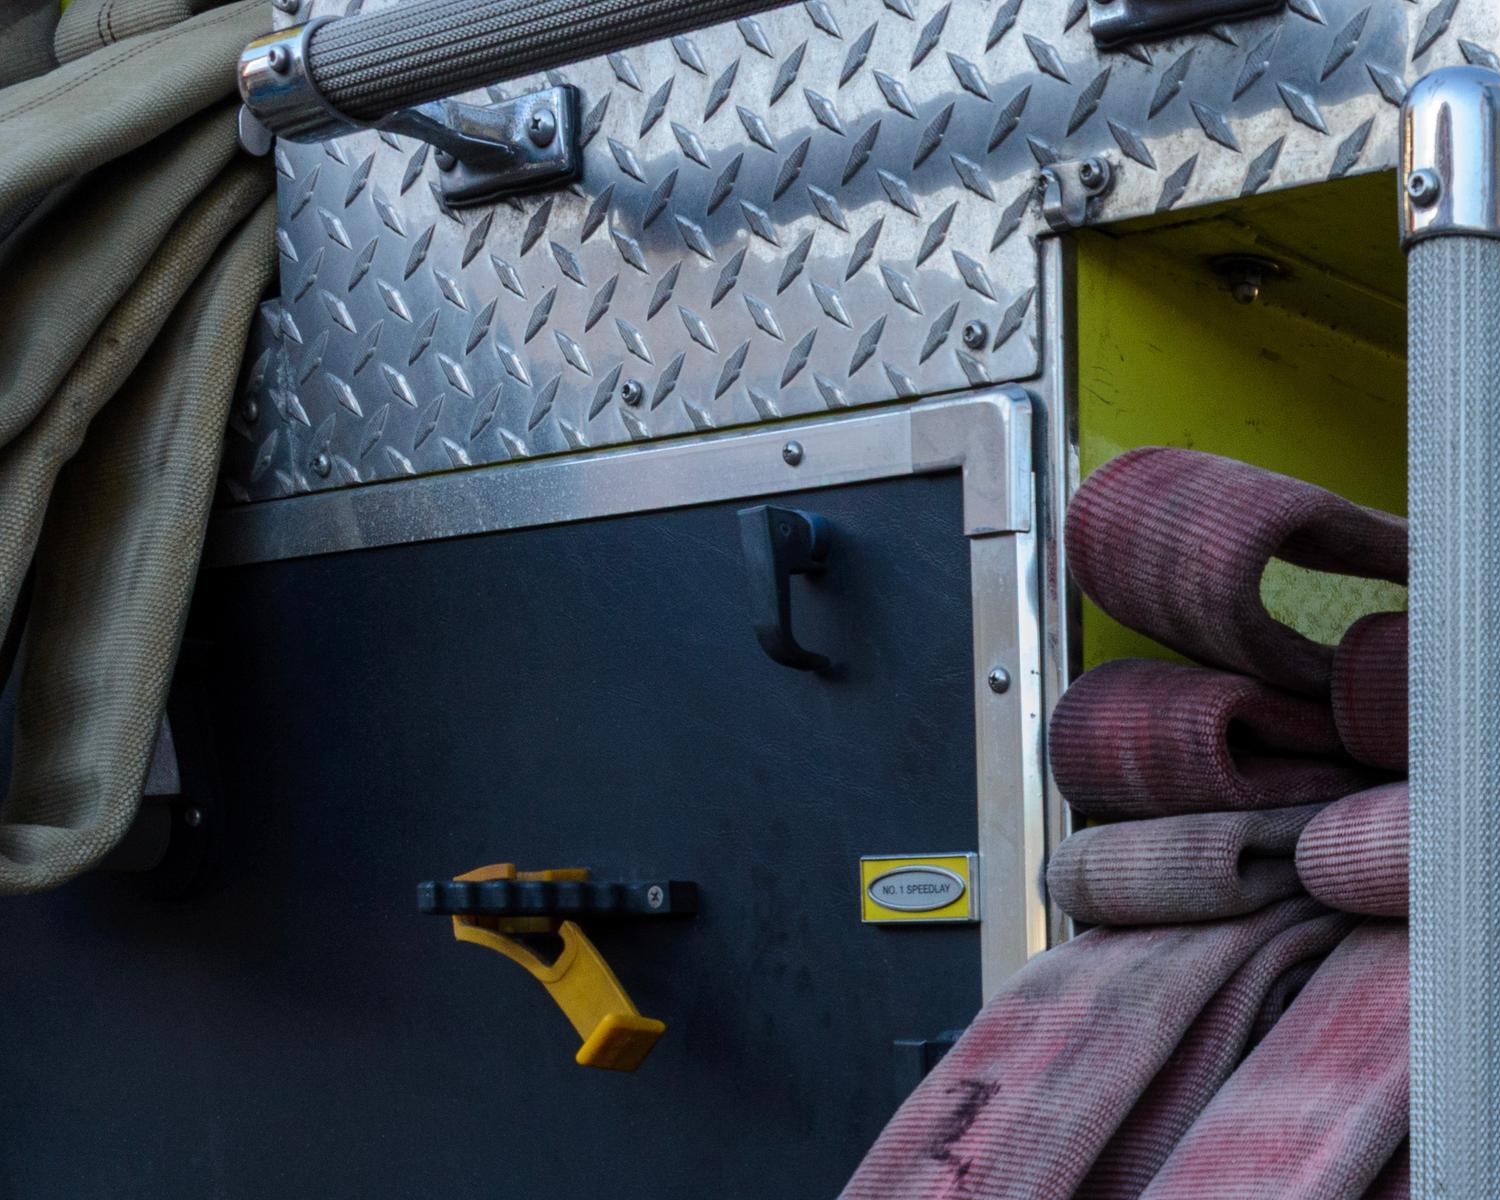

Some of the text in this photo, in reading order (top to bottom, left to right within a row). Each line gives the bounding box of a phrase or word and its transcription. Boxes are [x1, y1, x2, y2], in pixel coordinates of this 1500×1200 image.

[883, 884, 950, 895] NO. 1 SPEEDLAY
